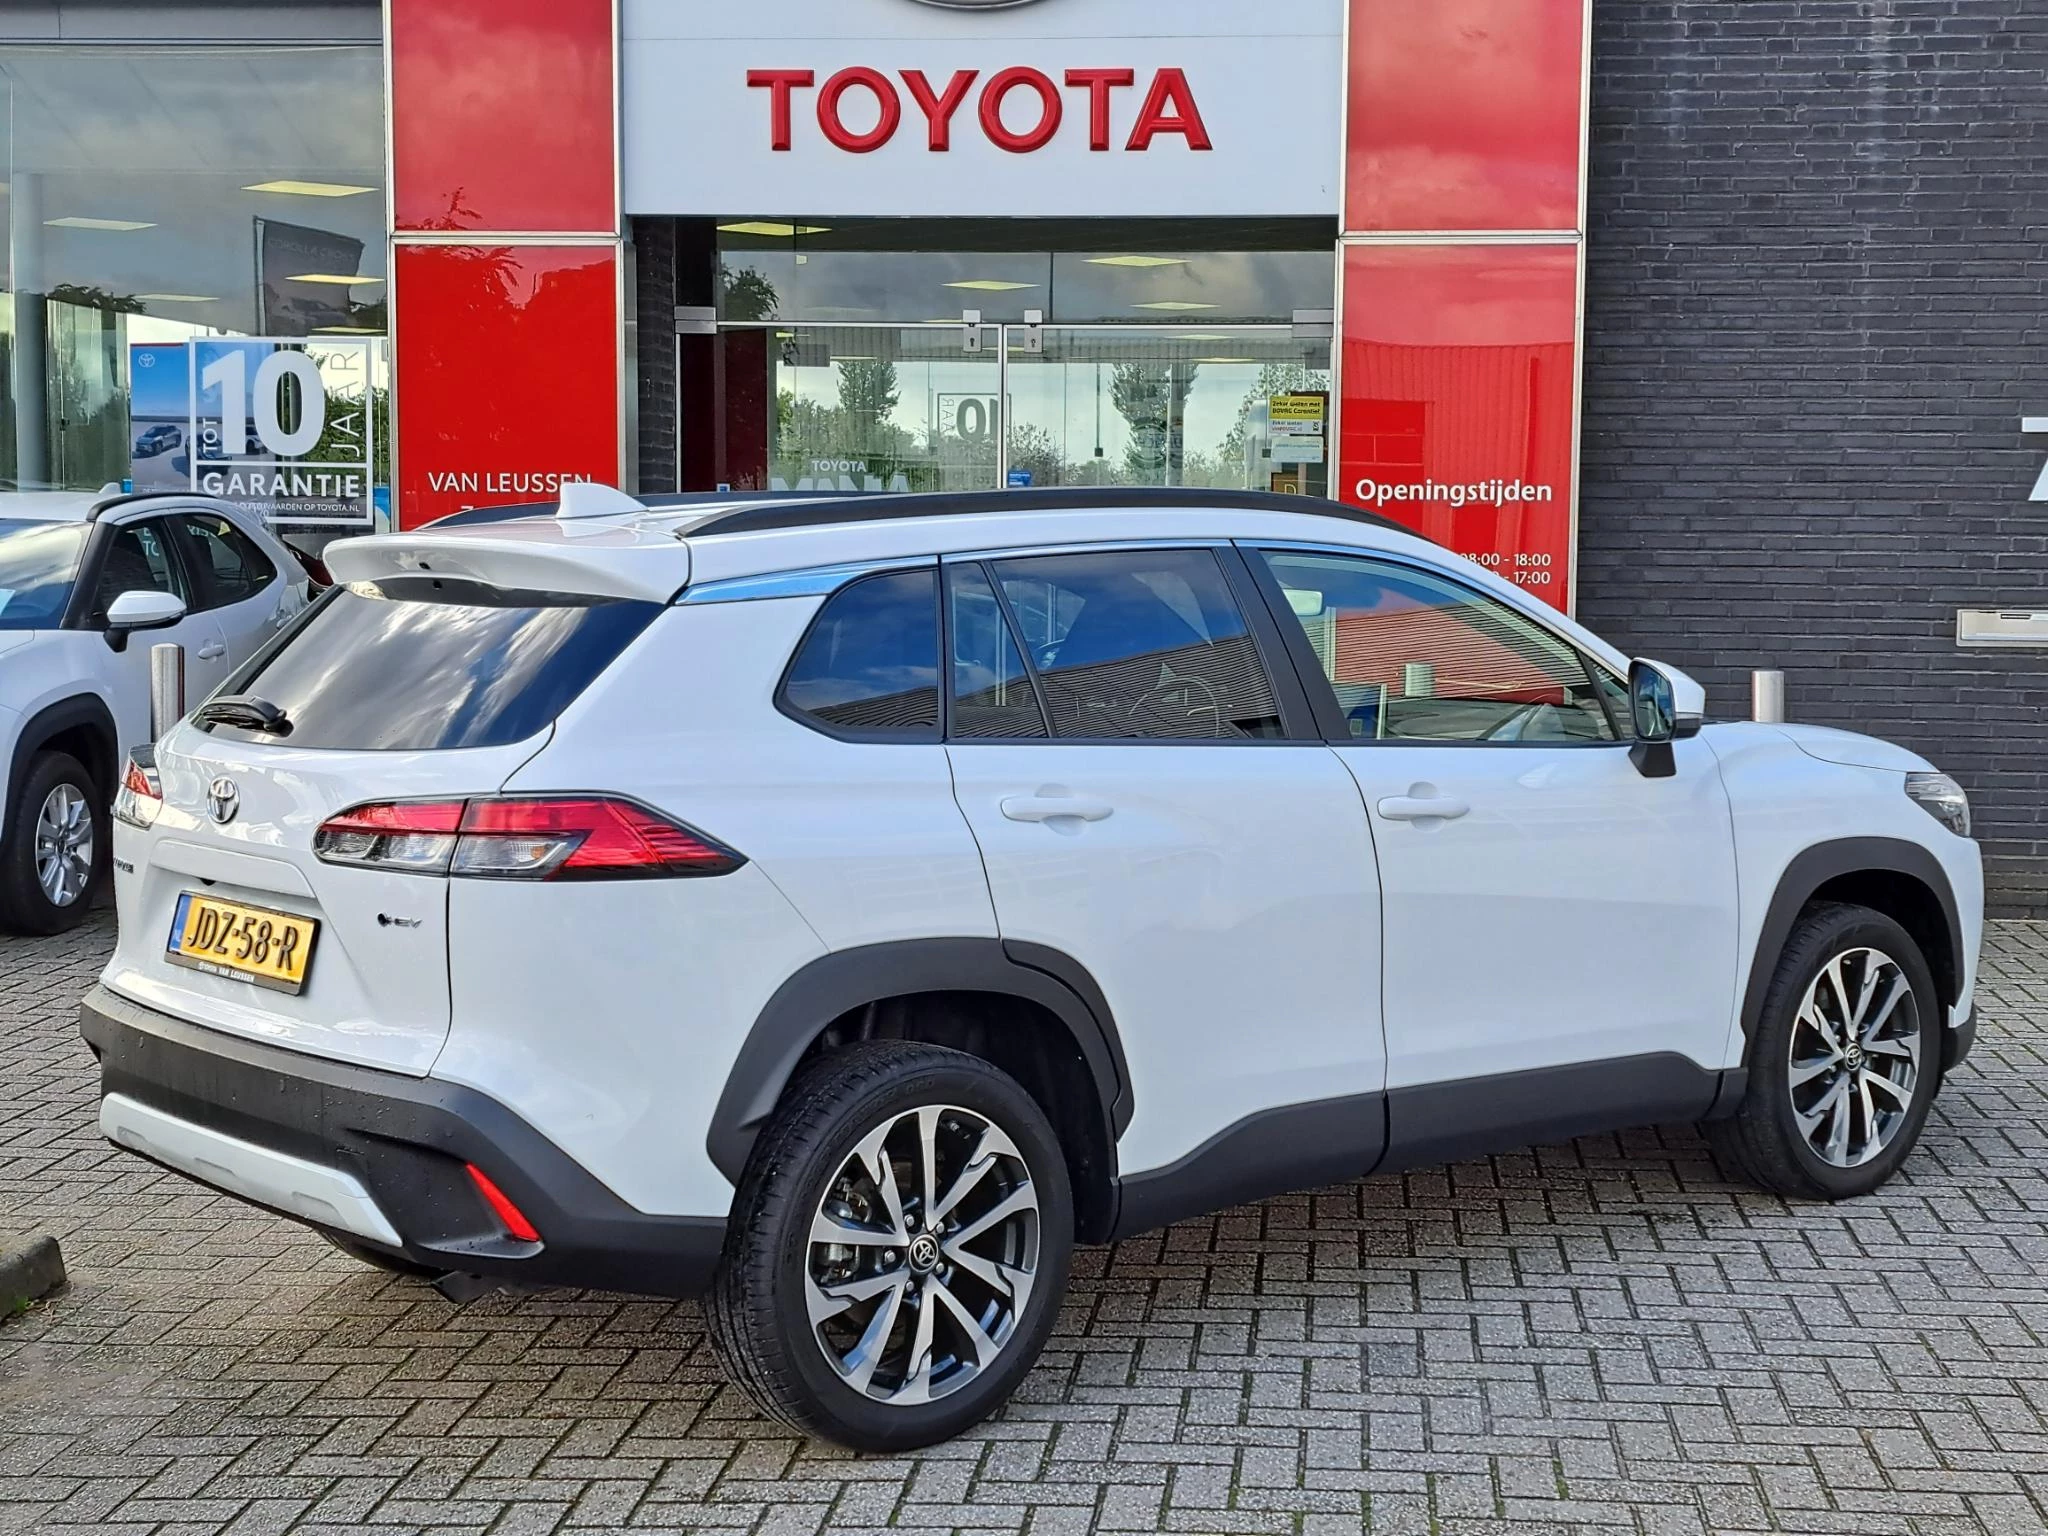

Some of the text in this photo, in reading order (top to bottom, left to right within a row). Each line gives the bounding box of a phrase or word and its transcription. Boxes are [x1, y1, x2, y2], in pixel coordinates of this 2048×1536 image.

[747, 65, 1213, 154] TOYOTA
[203, 350, 326, 456] 10
[330, 351, 360, 457] JAAR
[203, 418, 218, 453] TOT
[811, 460, 867, 472] TOYOTA
[202, 472, 360, 497] GARANTIE
[428, 472, 477, 492] VAN
[1355, 479, 1552, 507] Openingstijden
[304, 503, 316, 511] OP
[317, 504, 360, 512] TOYOTA.NL
[1514, 553, 1551, 566] 18:00
[1513, 571, 1551, 584] 17:00
[187, 907, 300, 970] JDZ-58-R
